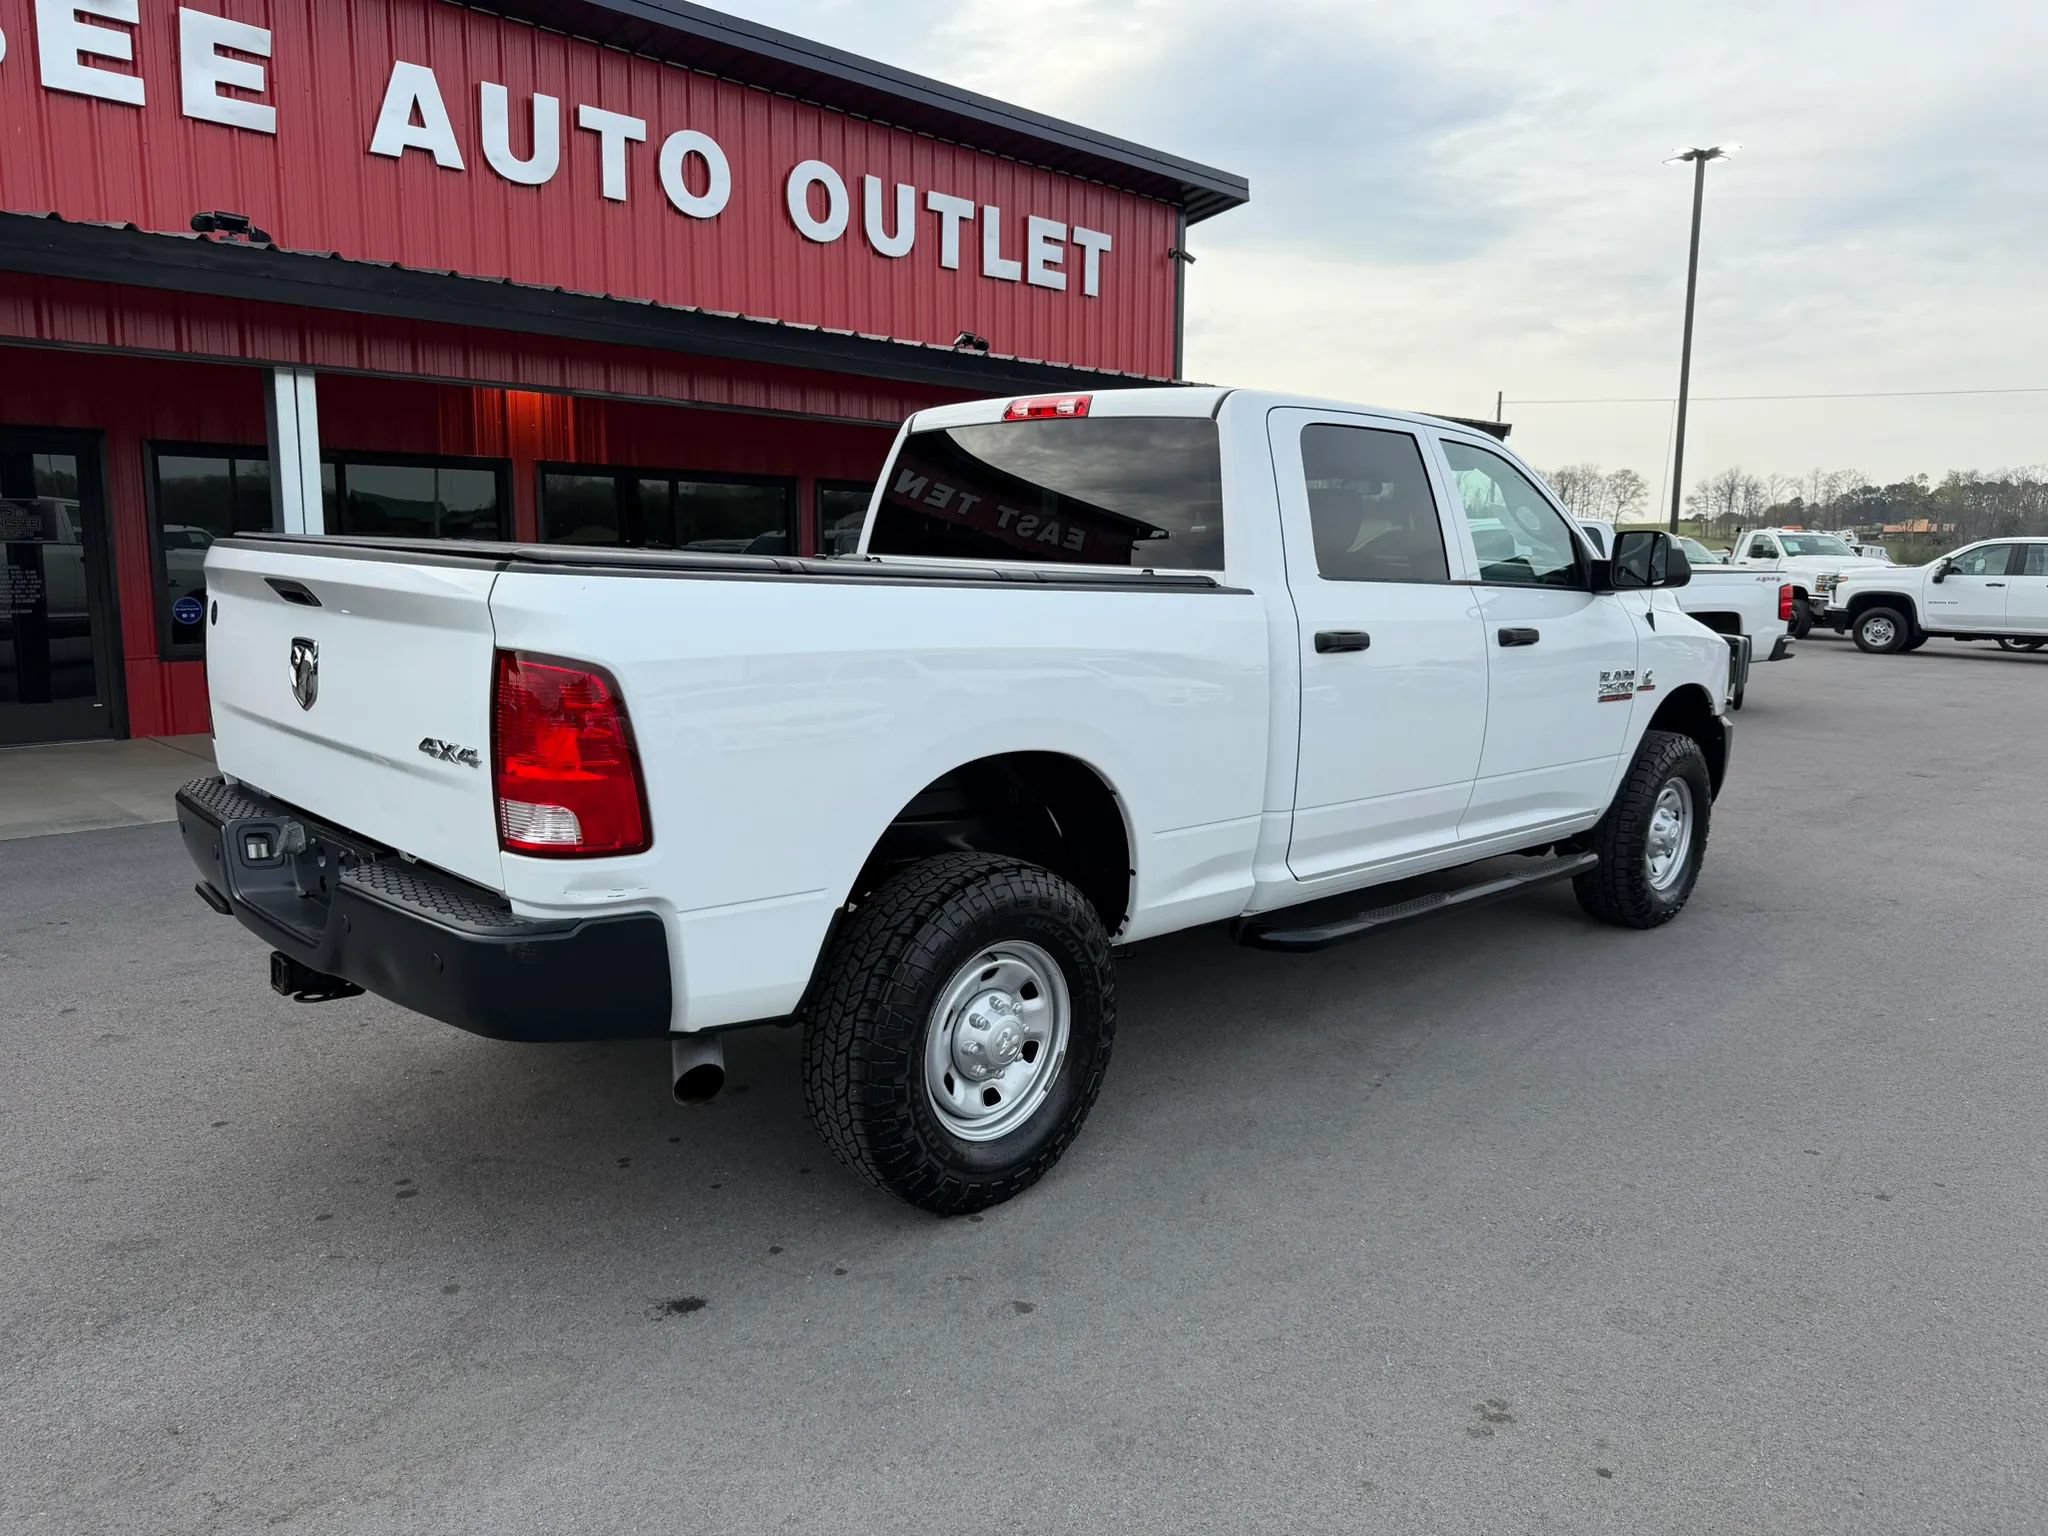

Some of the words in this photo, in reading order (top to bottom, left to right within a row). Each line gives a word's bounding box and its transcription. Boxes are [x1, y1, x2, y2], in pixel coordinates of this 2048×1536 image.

[0, 0, 277, 134] EE
[369, 60, 731, 219] AUTO
[787, 159, 1112, 297] OUTLET
[1599, 669, 1635, 682] RAM
